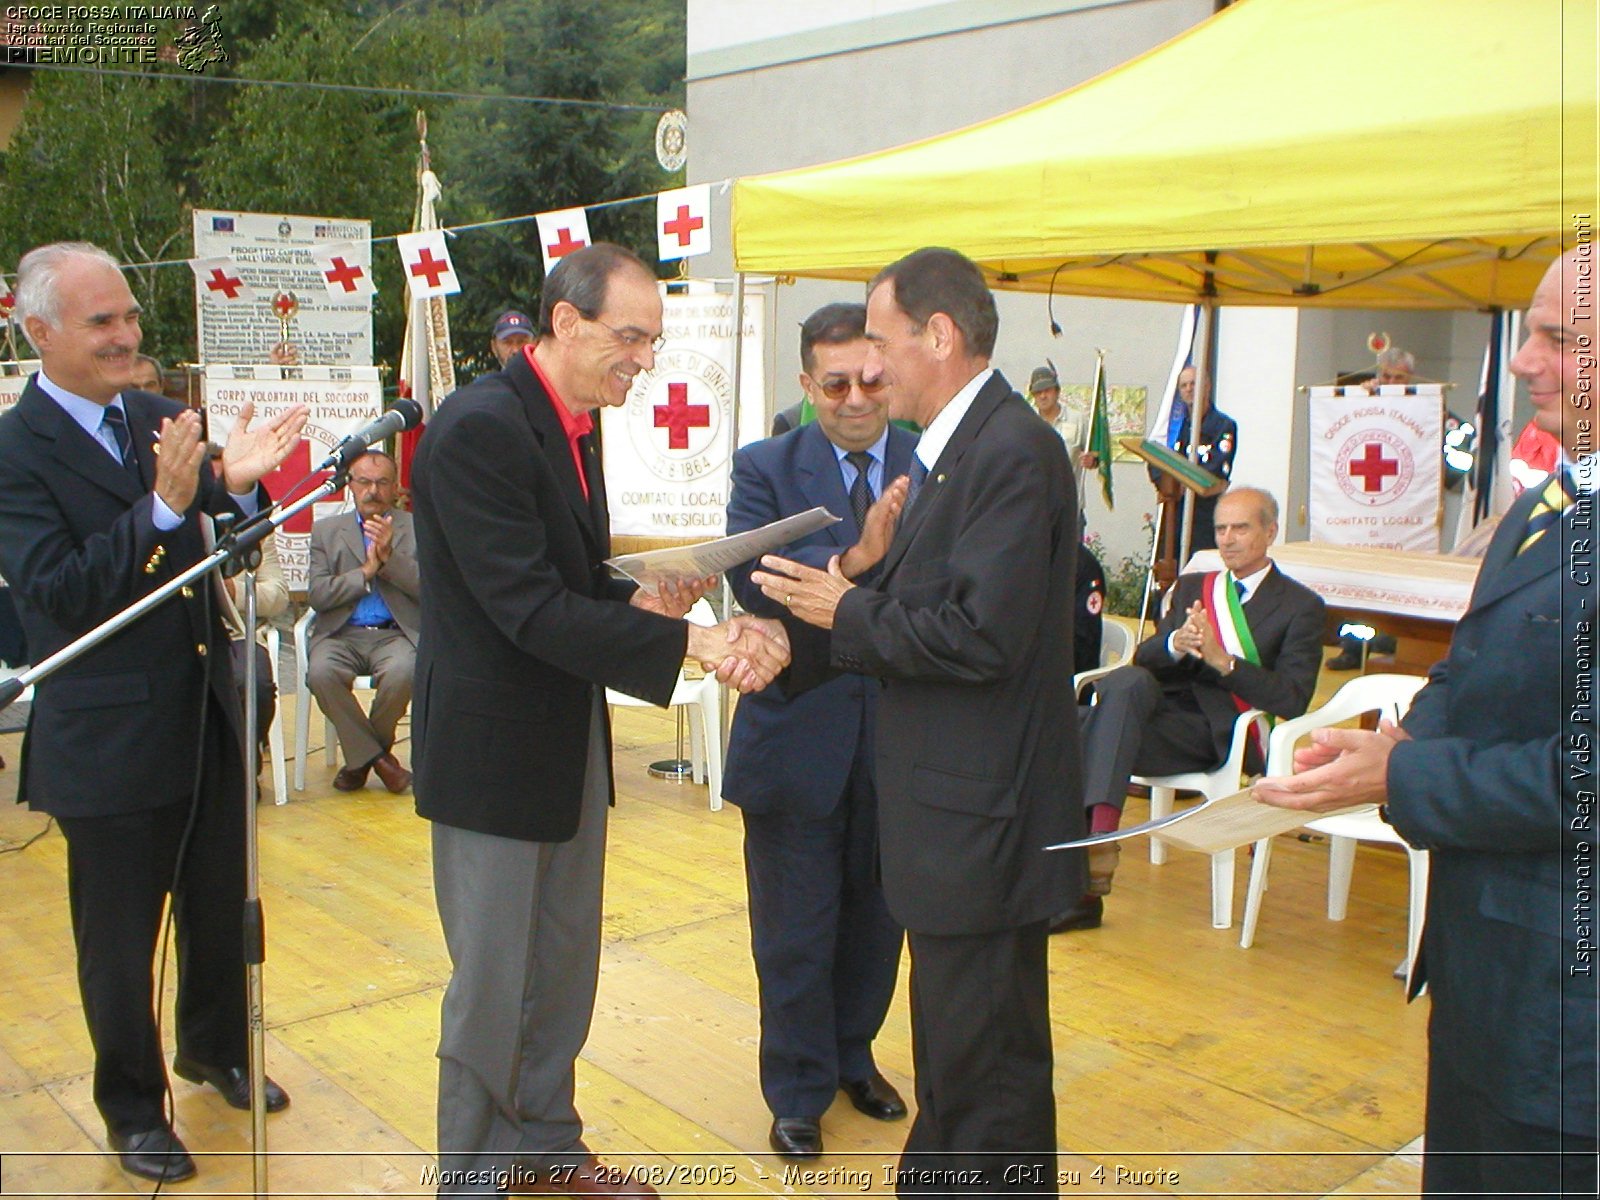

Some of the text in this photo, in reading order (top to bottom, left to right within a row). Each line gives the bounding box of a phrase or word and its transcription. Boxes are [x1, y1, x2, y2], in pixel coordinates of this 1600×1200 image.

[231, 246, 275, 256] PROGETTO
[217, 390, 369, 403] CORPO VOLONTARI DEL SOCCORSO
[209, 404, 259, 418] CROE
[316, 406, 378, 419] ITALIANA
[1354, 406, 1385, 419] ROSSA
[621, 491, 726, 506] COMITATO LOCAL
[652, 512, 722, 527] MONESIGLIO
[1326, 516, 1377, 526] COMITATO
